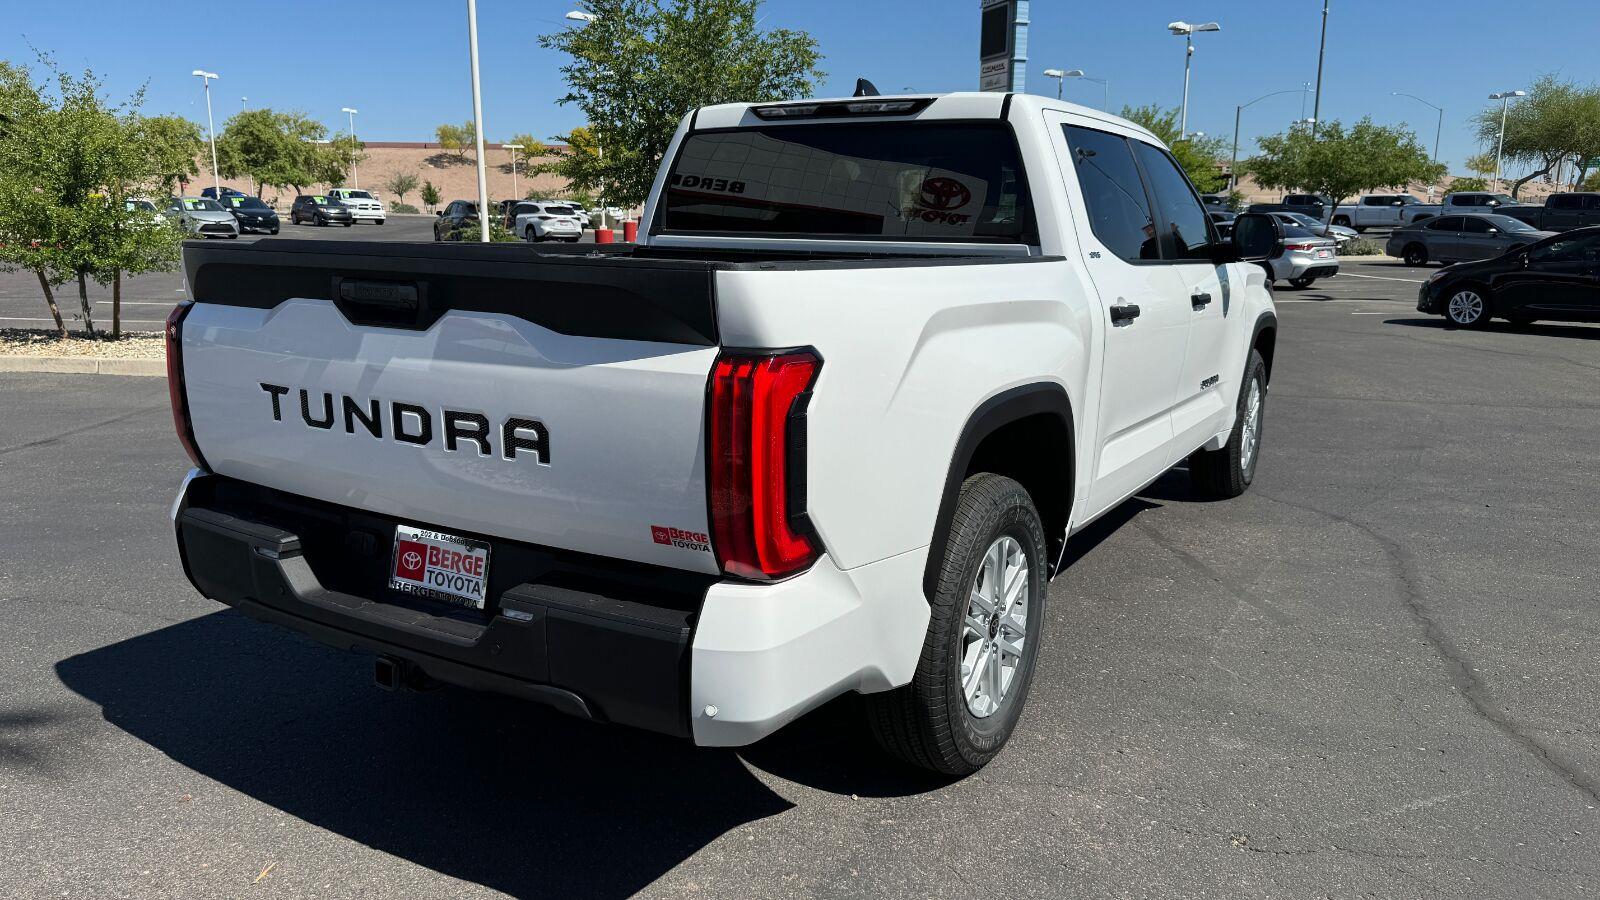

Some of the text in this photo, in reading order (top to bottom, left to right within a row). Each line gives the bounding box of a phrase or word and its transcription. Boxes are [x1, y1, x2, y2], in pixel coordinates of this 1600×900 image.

[258, 382, 551, 467] TUNDRA
[669, 527, 709, 543] BERGE
[672, 540, 711, 552] TOYOTA
[428, 546, 484, 577] BERGE
[427, 569, 481, 596] TOYOTA
